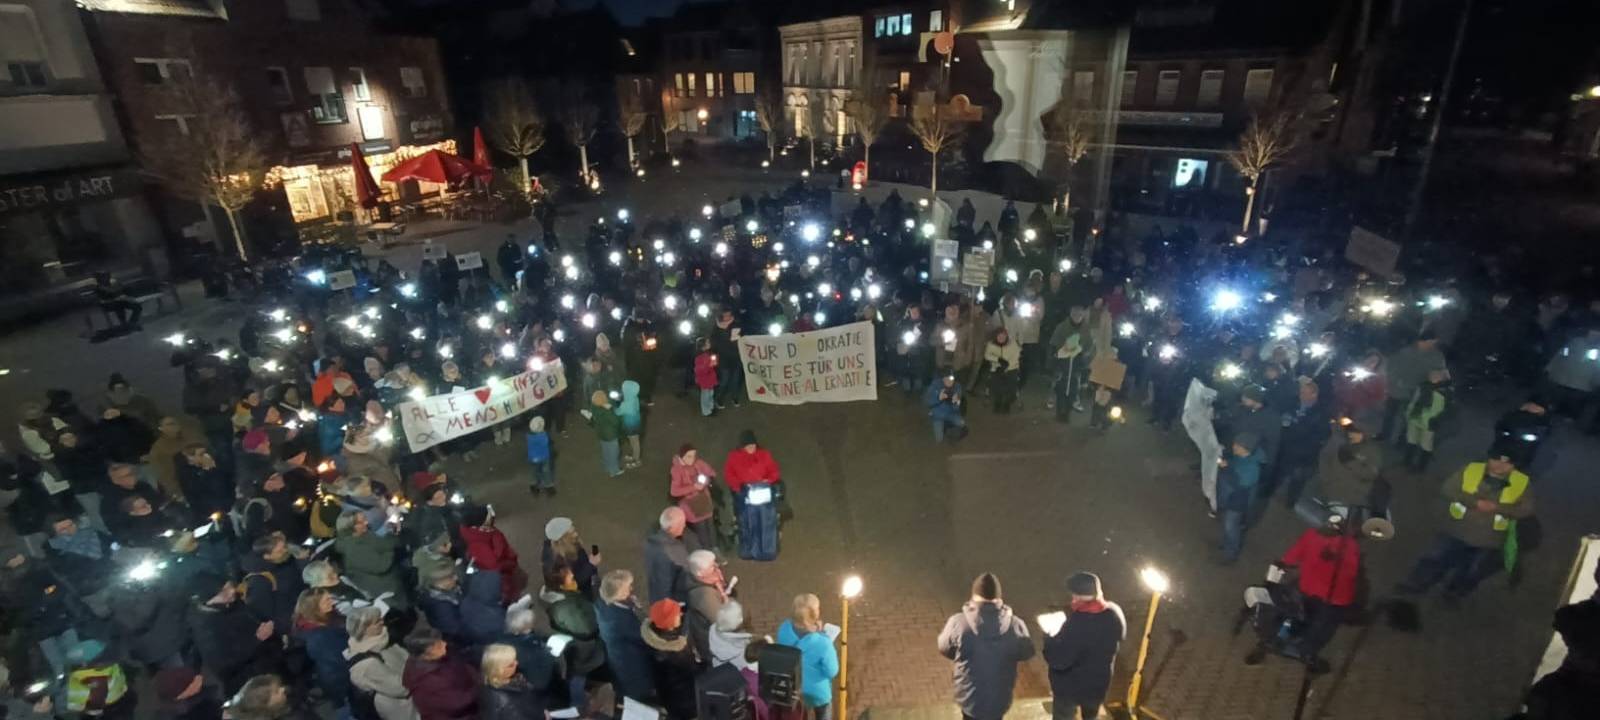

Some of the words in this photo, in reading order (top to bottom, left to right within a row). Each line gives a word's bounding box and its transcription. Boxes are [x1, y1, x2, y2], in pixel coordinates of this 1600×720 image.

[80, 176, 113, 196] ART
[744, 343, 778, 360] ZUR
[784, 363, 802, 379] ES
[807, 356, 833, 375] FÜR
[837, 353, 864, 369] UNS
[412, 397, 460, 421] ALLE
